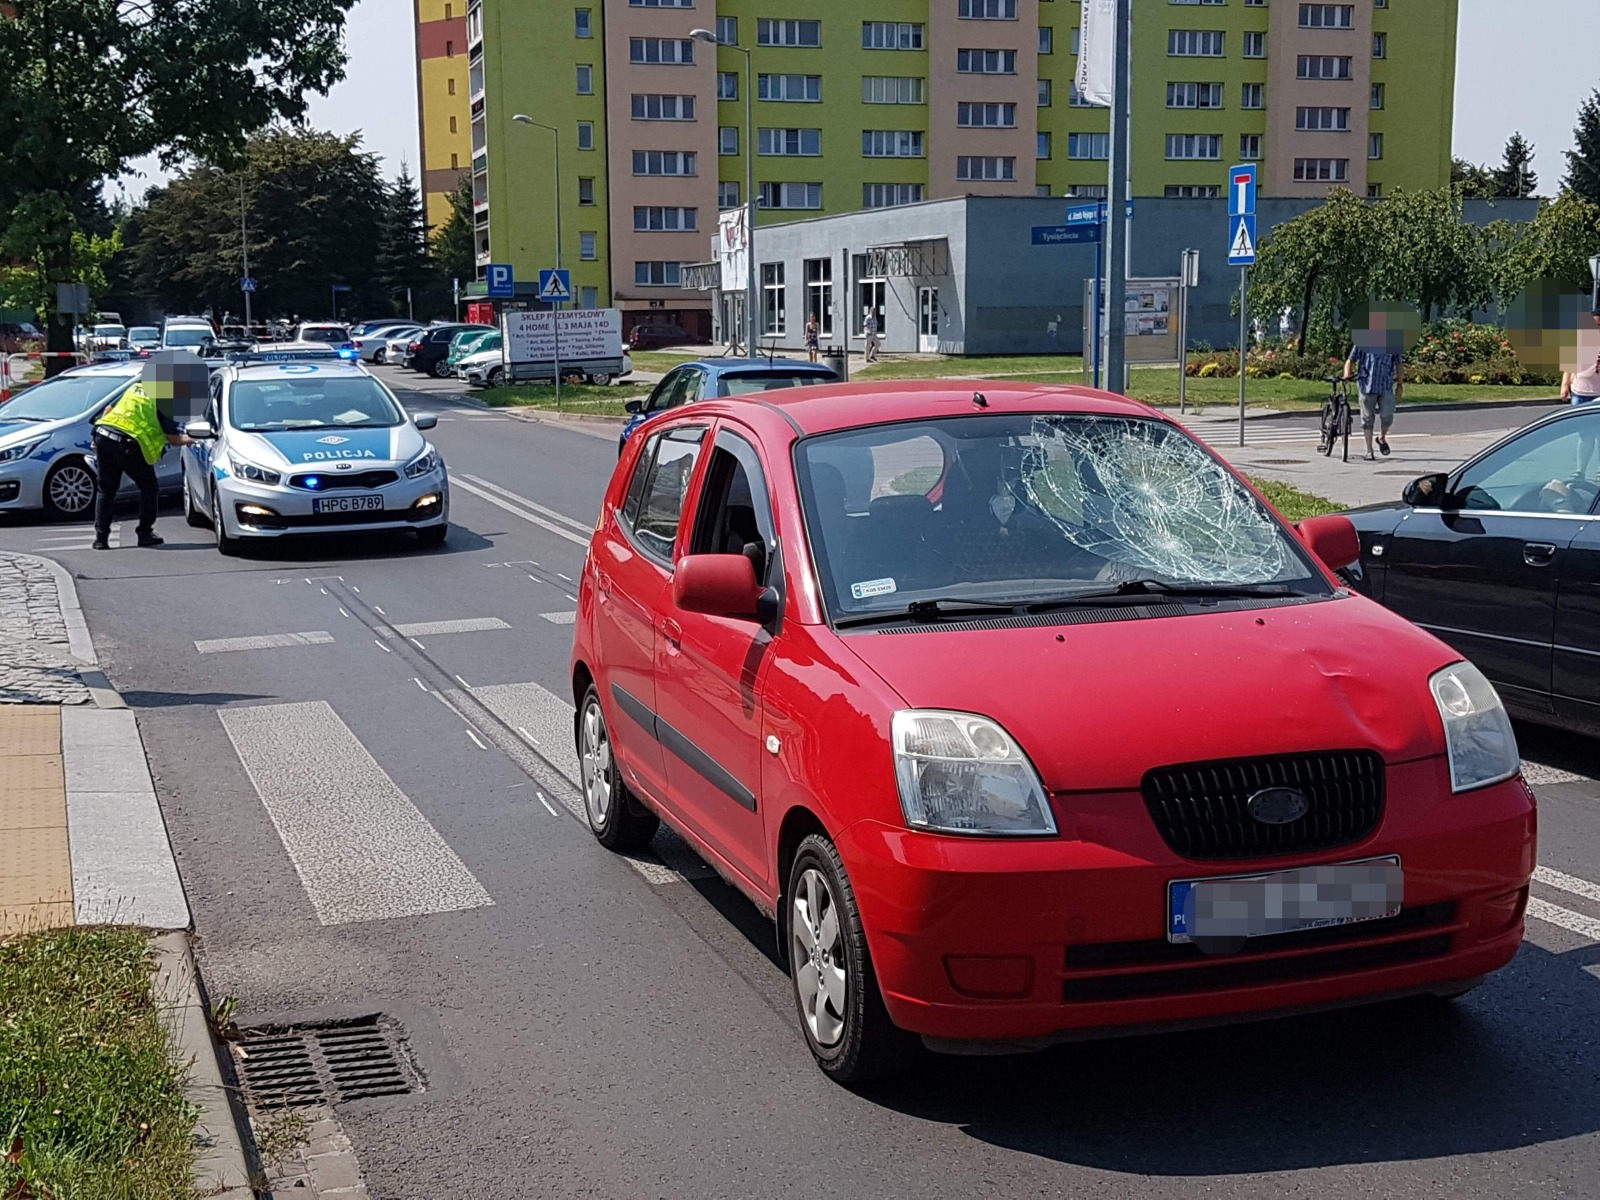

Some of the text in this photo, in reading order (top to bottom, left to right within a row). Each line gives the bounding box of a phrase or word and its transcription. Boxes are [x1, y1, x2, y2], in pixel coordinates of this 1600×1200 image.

[493, 266, 507, 287] P
[521, 313, 545, 321] SKLEP
[570, 321, 592, 329] MAJA
[303, 450, 376, 461] POLICJA
[321, 498, 348, 512] HPG
[352, 497, 381, 510] B789
